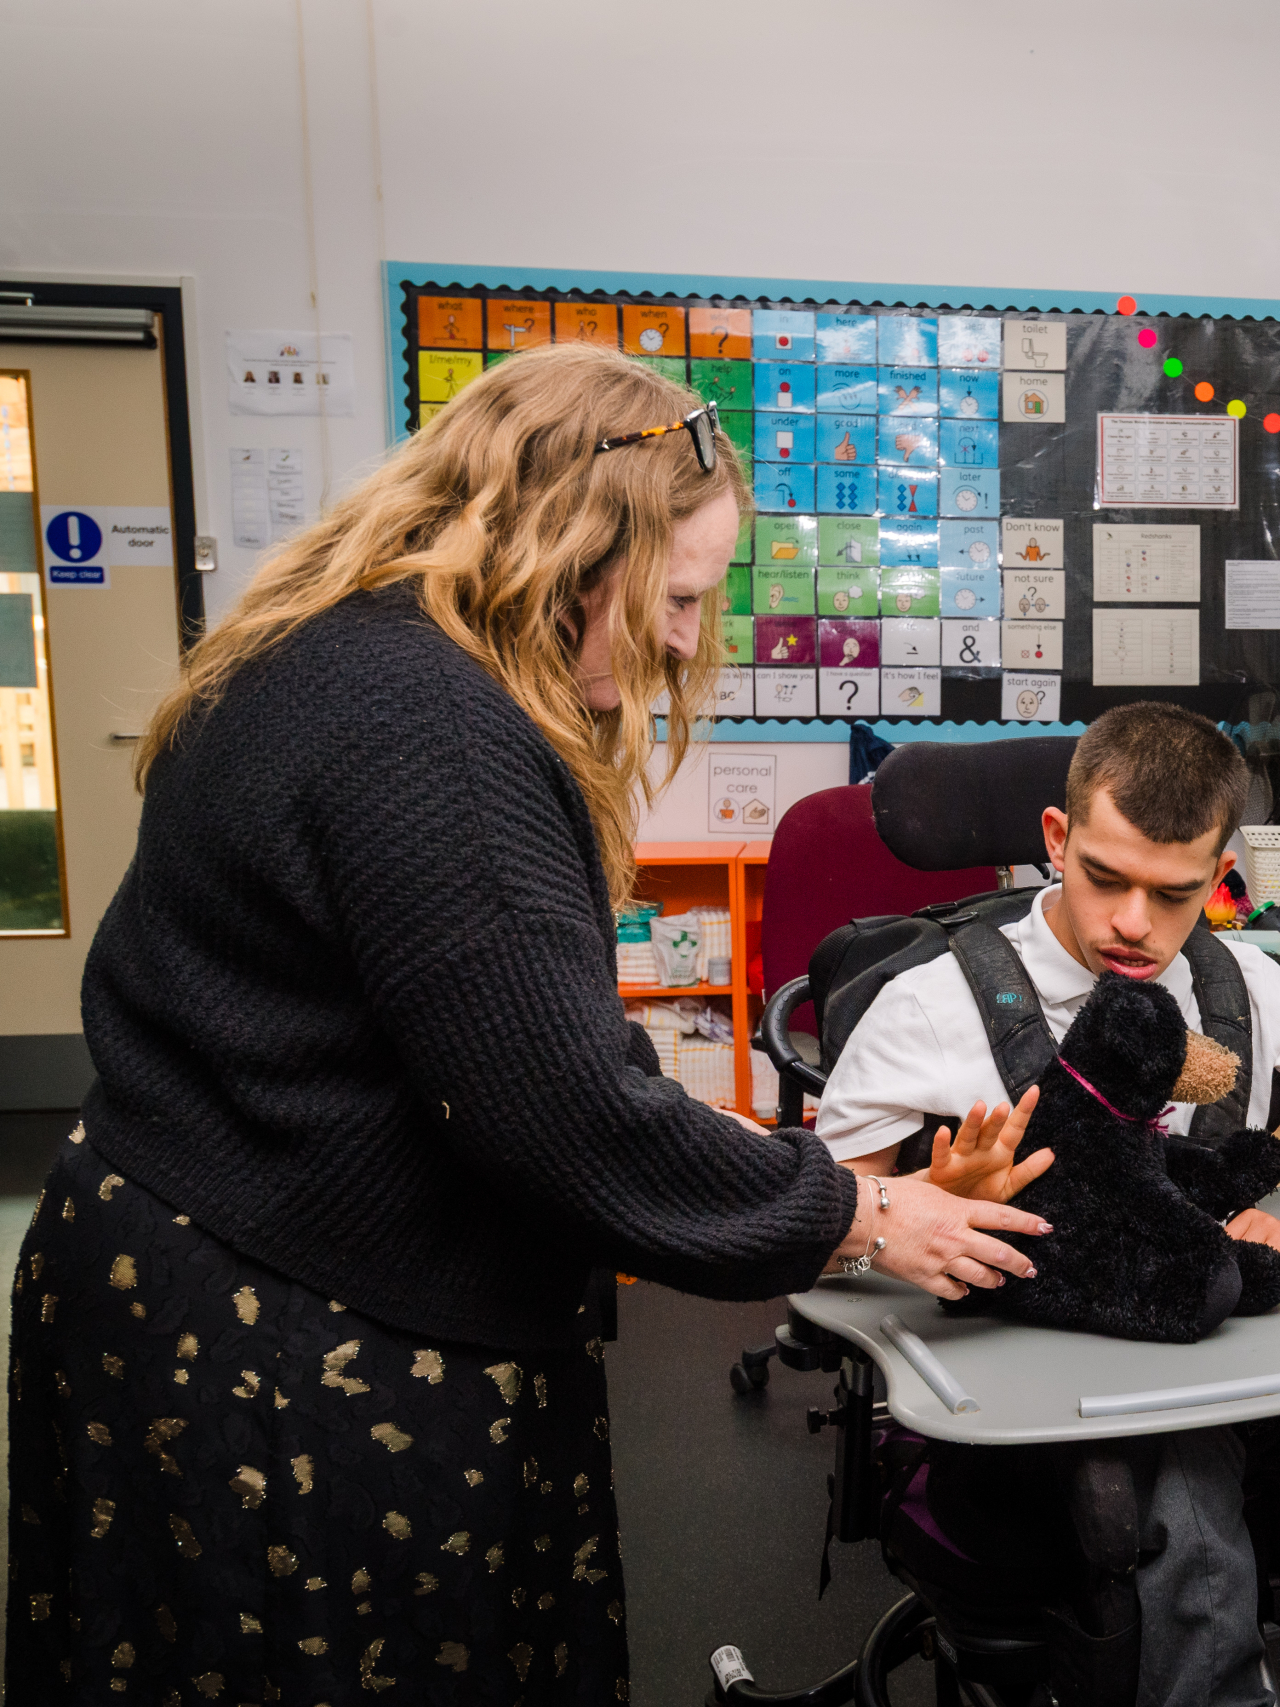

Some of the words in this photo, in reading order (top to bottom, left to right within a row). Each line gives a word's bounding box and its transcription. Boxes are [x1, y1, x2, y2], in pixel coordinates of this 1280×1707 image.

[438, 302, 462, 311] what
[503, 304, 534, 314] where
[575, 306, 597, 316] who
[640, 308, 668, 318] when
[779, 314, 789, 323] in
[835, 316, 857, 326] here
[1022, 323, 1048, 334] toilet
[710, 363, 733, 374] help
[778, 367, 792, 376] on
[834, 369, 860, 378] more
[889, 370, 927, 382] finished
[959, 374, 980, 383] now
[1019, 376, 1048, 386] home
[771, 417, 799, 426] under
[834, 419, 858, 430] good
[959, 424, 980, 433] next
[777, 467, 791, 476] off
[834, 469, 860, 479] same
[959, 472, 982, 482] later
[111, 525, 170, 534] Automatic
[836, 521, 861, 530] close
[896, 523, 923, 533] again
[963, 525, 984, 534] past
[1005, 523, 1032, 532] Don't
[1034, 523, 1060, 532] know
[128, 538, 155, 548] door
[52, 570, 77, 580] Keep
[79, 570, 102, 579] clear
[757, 569, 809, 580] hear/listen
[836, 571, 861, 580] think
[955, 572, 985, 582] future
[1014, 575, 1031, 583] not
[962, 623, 980, 632] and
[1007, 624, 1042, 632] something
[799, 673, 814, 681] you
[883, 671, 896, 680] it's
[897, 672, 915, 680] how
[917, 672, 921, 680] I
[923, 672, 939, 680] feel
[1007, 678, 1029, 687] start
[1031, 679, 1056, 688] again
[713, 764, 772, 777] personal
[726, 782, 758, 794] care
